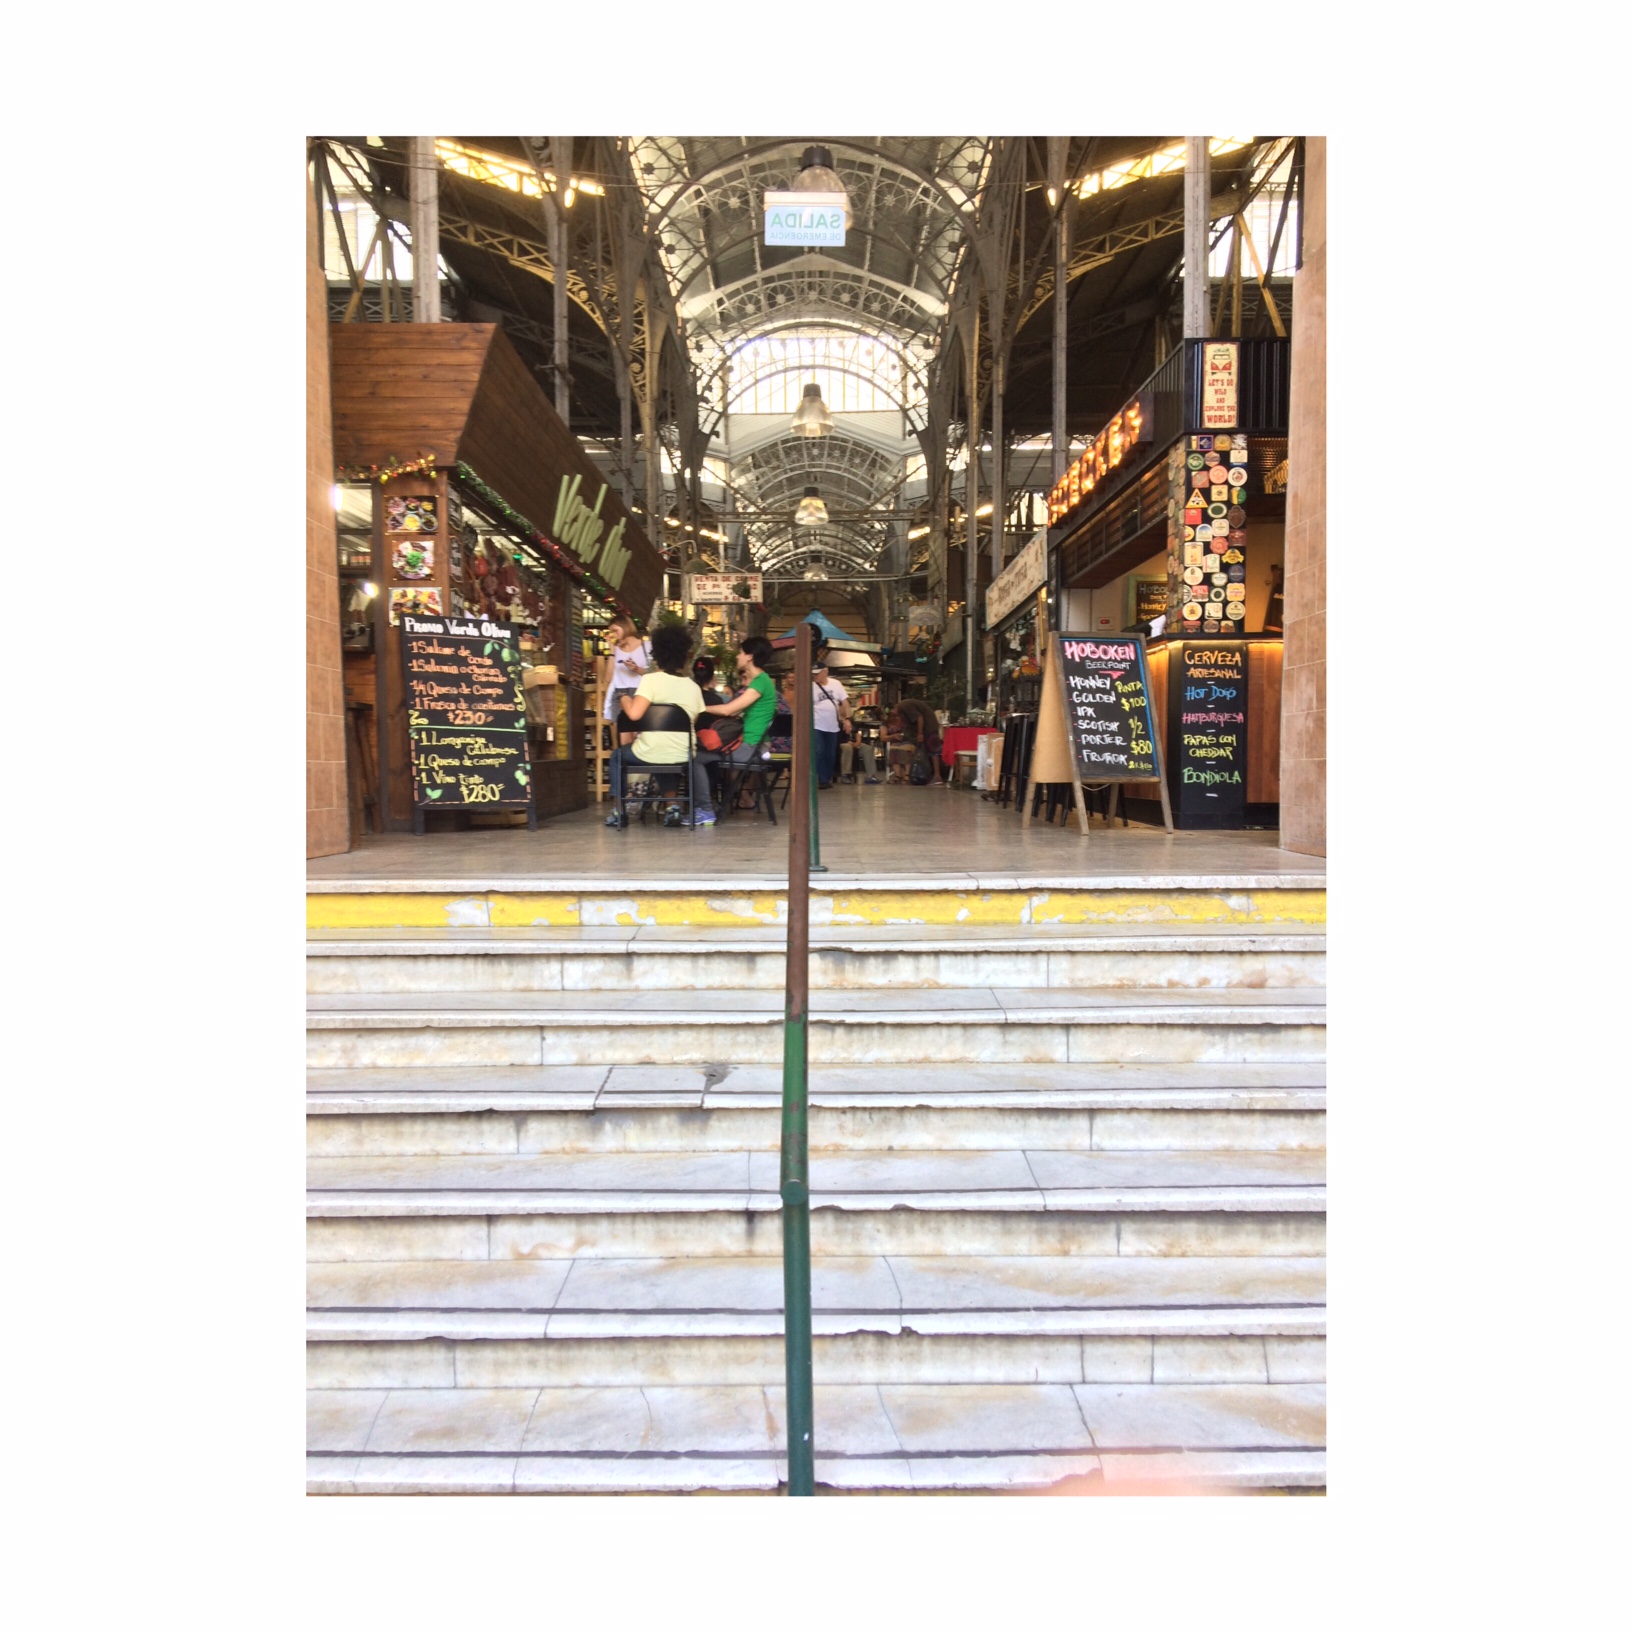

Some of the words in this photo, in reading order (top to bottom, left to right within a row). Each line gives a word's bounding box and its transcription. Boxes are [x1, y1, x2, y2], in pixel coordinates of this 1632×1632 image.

[1206, 414, 1236, 424] WORLD!
[552, 474, 608, 564] Verde
[458, 646, 472, 656] de
[1064, 641, 1136, 662] HOBOKEN
[1184, 650, 1242, 666] CERVEZA
[1086, 660, 1108, 670] BEER
[1108, 661, 1132, 670] POINT
[1186, 667, 1242, 679] ARTESANAL
[426, 681, 458, 698] Queso
[458, 682, 472, 694] de
[1069, 675, 1111, 690] HONNEY
[1114, 680, 1144, 693] PINTA
[1072, 691, 1116, 704] GOLDEN
[1184, 686, 1208, 700] HOT
[1208, 686, 1236, 700] DOGS
[456, 698, 469, 710] de
[1120, 696, 1146, 712] $100
[1076, 706, 1096, 718] IPA
[1078, 720, 1120, 732] SCOTISH
[1182, 712, 1244, 727] HAMBURGUESA
[1128, 716, 1146, 739] 1/2
[1081, 734, 1127, 746] PORTER
[1183, 734, 1217, 746] PAPAS
[1218, 734, 1236, 746] CON
[1130, 740, 1152, 756] $80
[1189, 746, 1234, 760] CHEDDAR
[427, 754, 460, 770] Queso
[462, 755, 474, 766] de
[473, 758, 506, 768] campo
[432, 770, 456, 784] Vino
[458, 773, 484, 785] tinto
